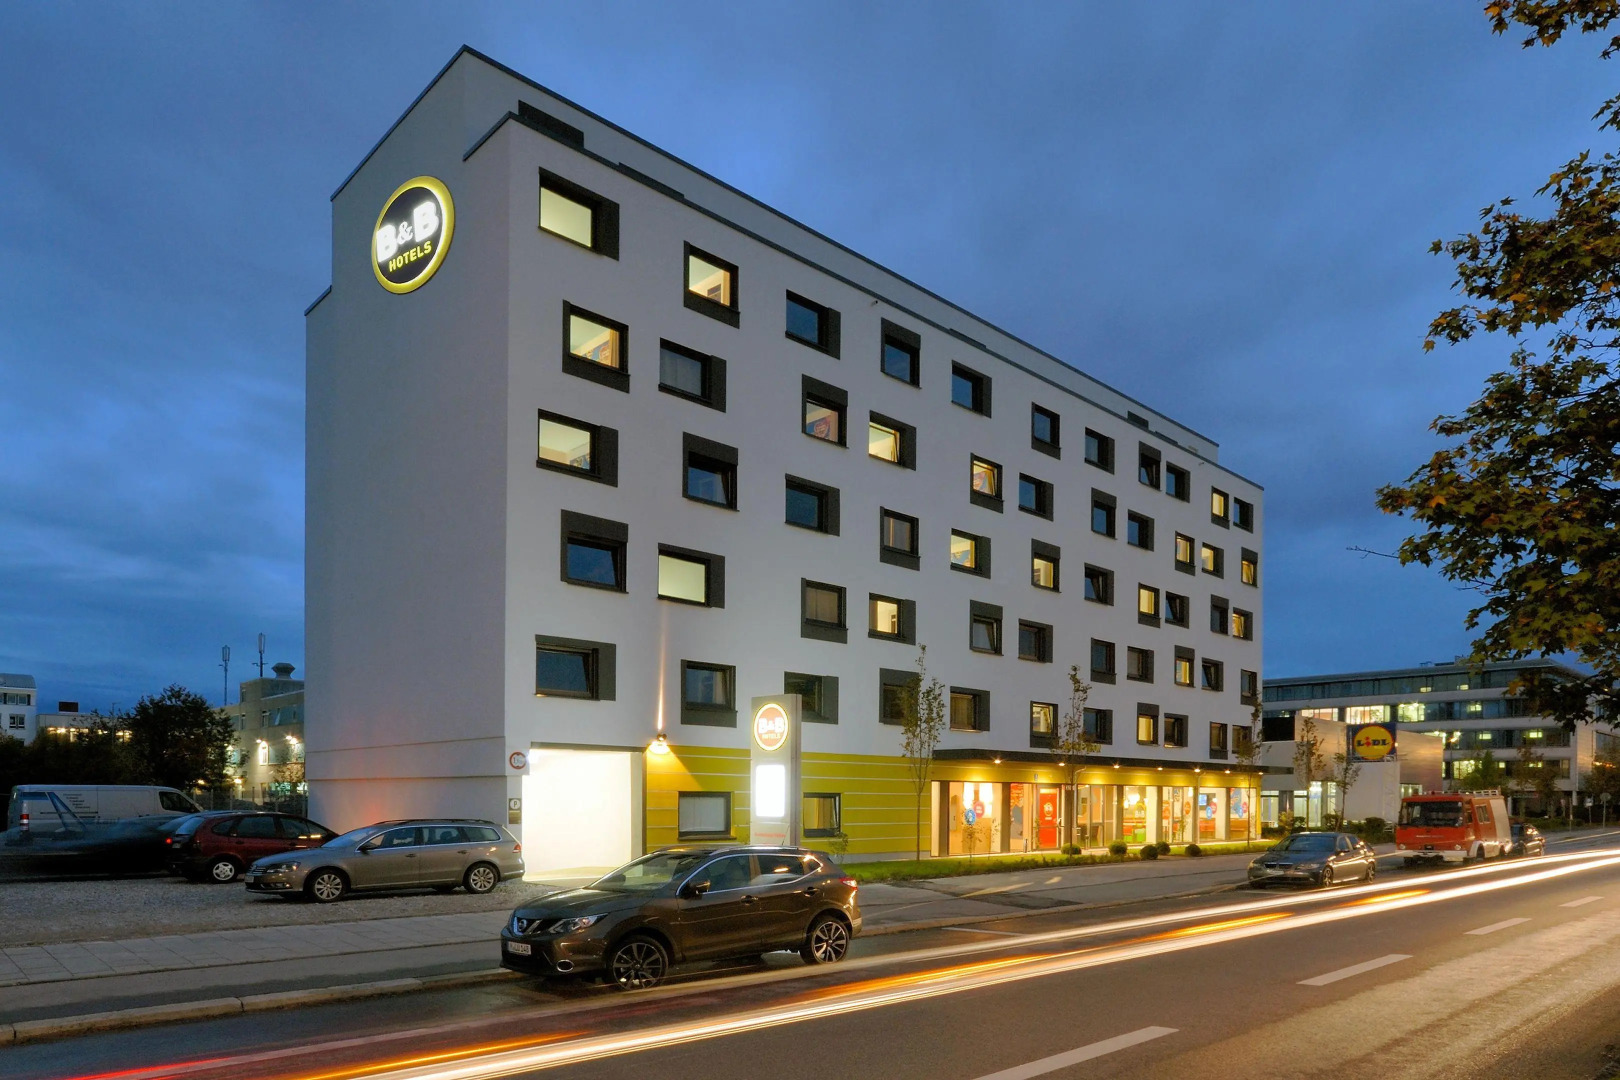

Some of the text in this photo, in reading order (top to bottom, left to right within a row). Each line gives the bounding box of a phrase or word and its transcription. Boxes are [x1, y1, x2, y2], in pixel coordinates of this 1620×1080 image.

[376, 201, 440, 263] B&B
[388, 240, 432, 273] HOTELS
[758, 716, 785, 734] B&B
